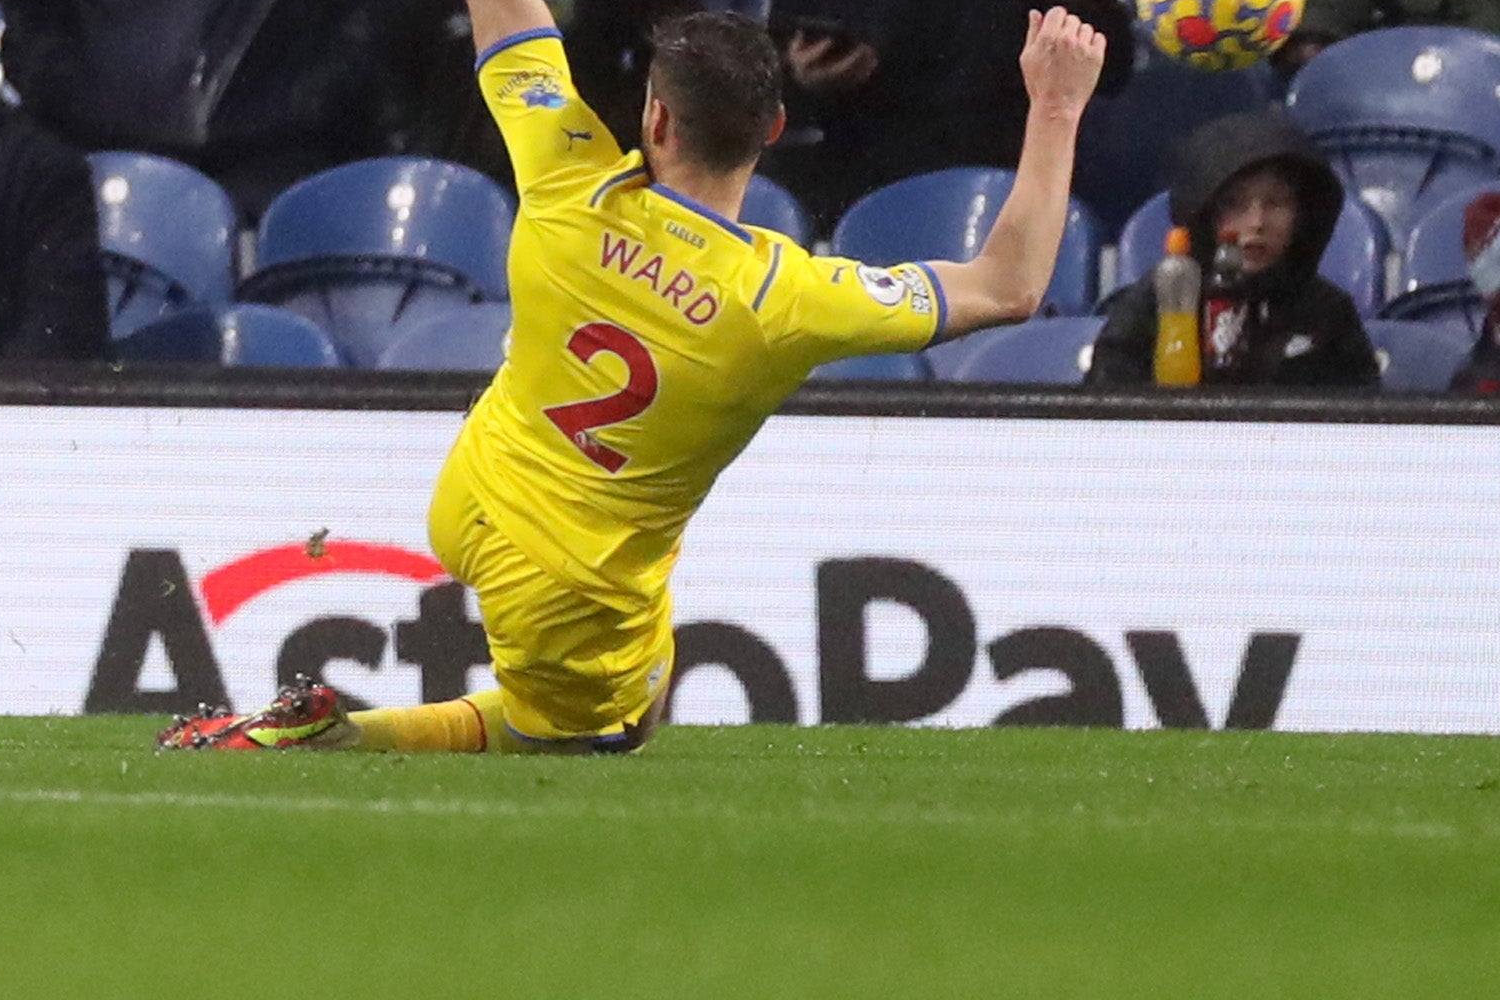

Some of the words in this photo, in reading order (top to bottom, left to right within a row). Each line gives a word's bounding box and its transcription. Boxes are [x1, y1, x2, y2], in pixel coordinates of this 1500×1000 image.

[601, 232, 718, 326] WARD
[542, 321, 659, 475] 2
[84, 547, 1301, 731] AstoPay
